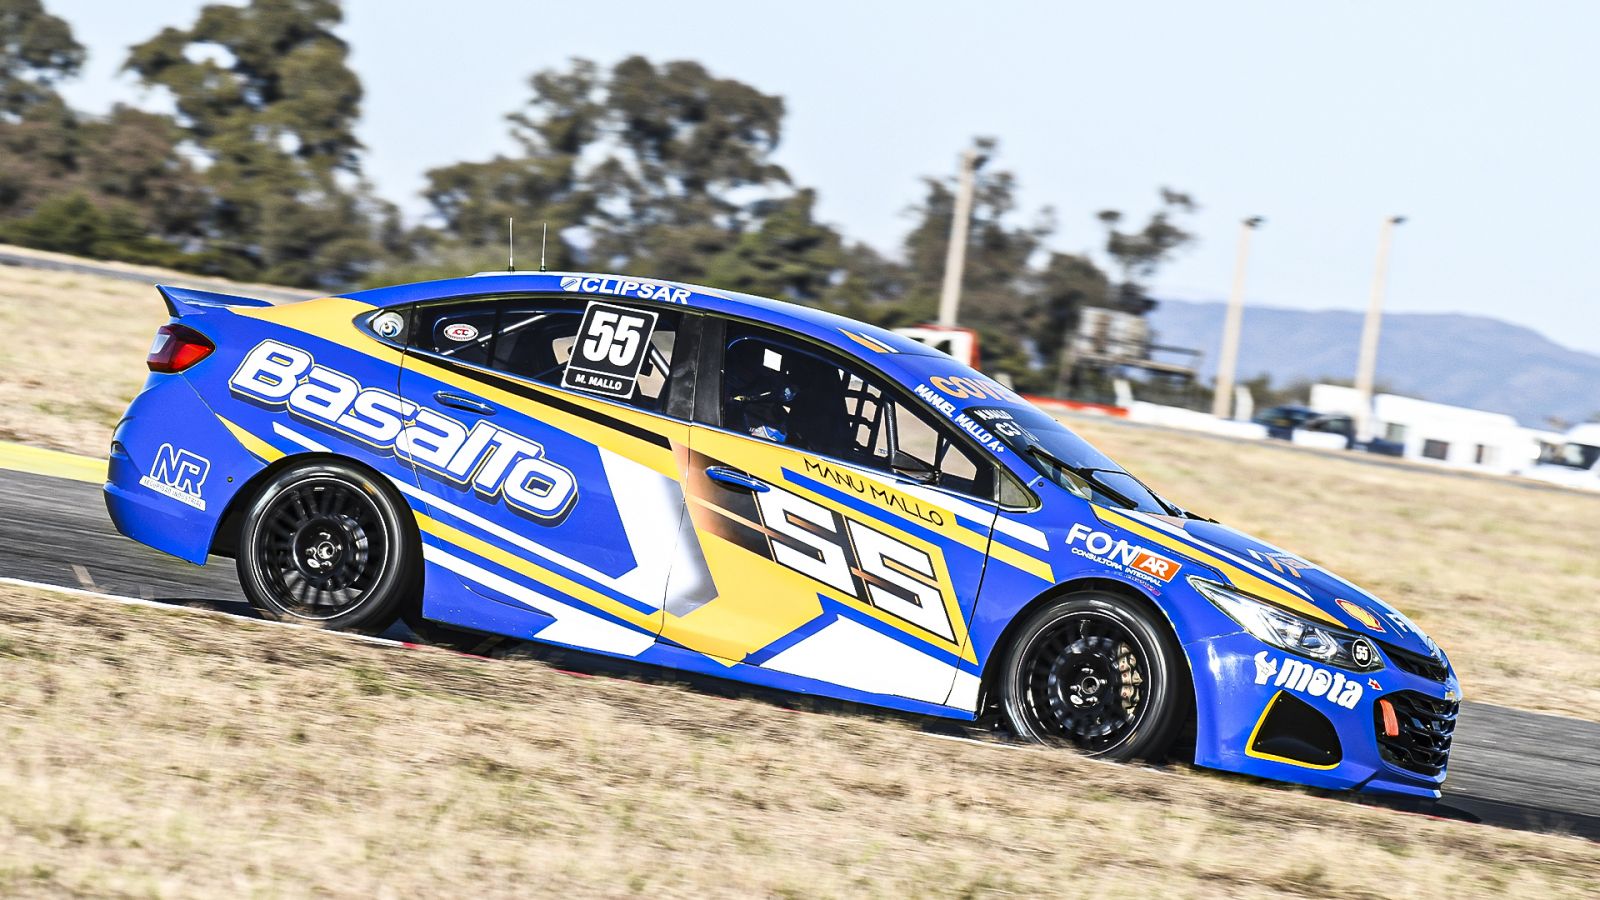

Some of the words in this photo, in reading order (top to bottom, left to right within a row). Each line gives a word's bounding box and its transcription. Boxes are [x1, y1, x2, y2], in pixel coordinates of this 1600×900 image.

[582, 278, 691, 305] CLIPSAR
[582, 310, 645, 367] 55
[575, 374, 587, 384] M.
[588, 376, 622, 391] MALLO
[914, 384, 956, 417] MANUEL
[955, 413, 992, 444] MALLO
[149, 442, 211, 498] NR
[803, 457, 864, 494] MANU
[869, 484, 944, 527] MALLO
[754, 480, 960, 647] 55
[1071, 547, 1123, 571] CONSULTORA
[1124, 568, 1163, 587] INTEGRAL
[1355, 645, 1369, 661] 55
[1274, 657, 1364, 710] mota
